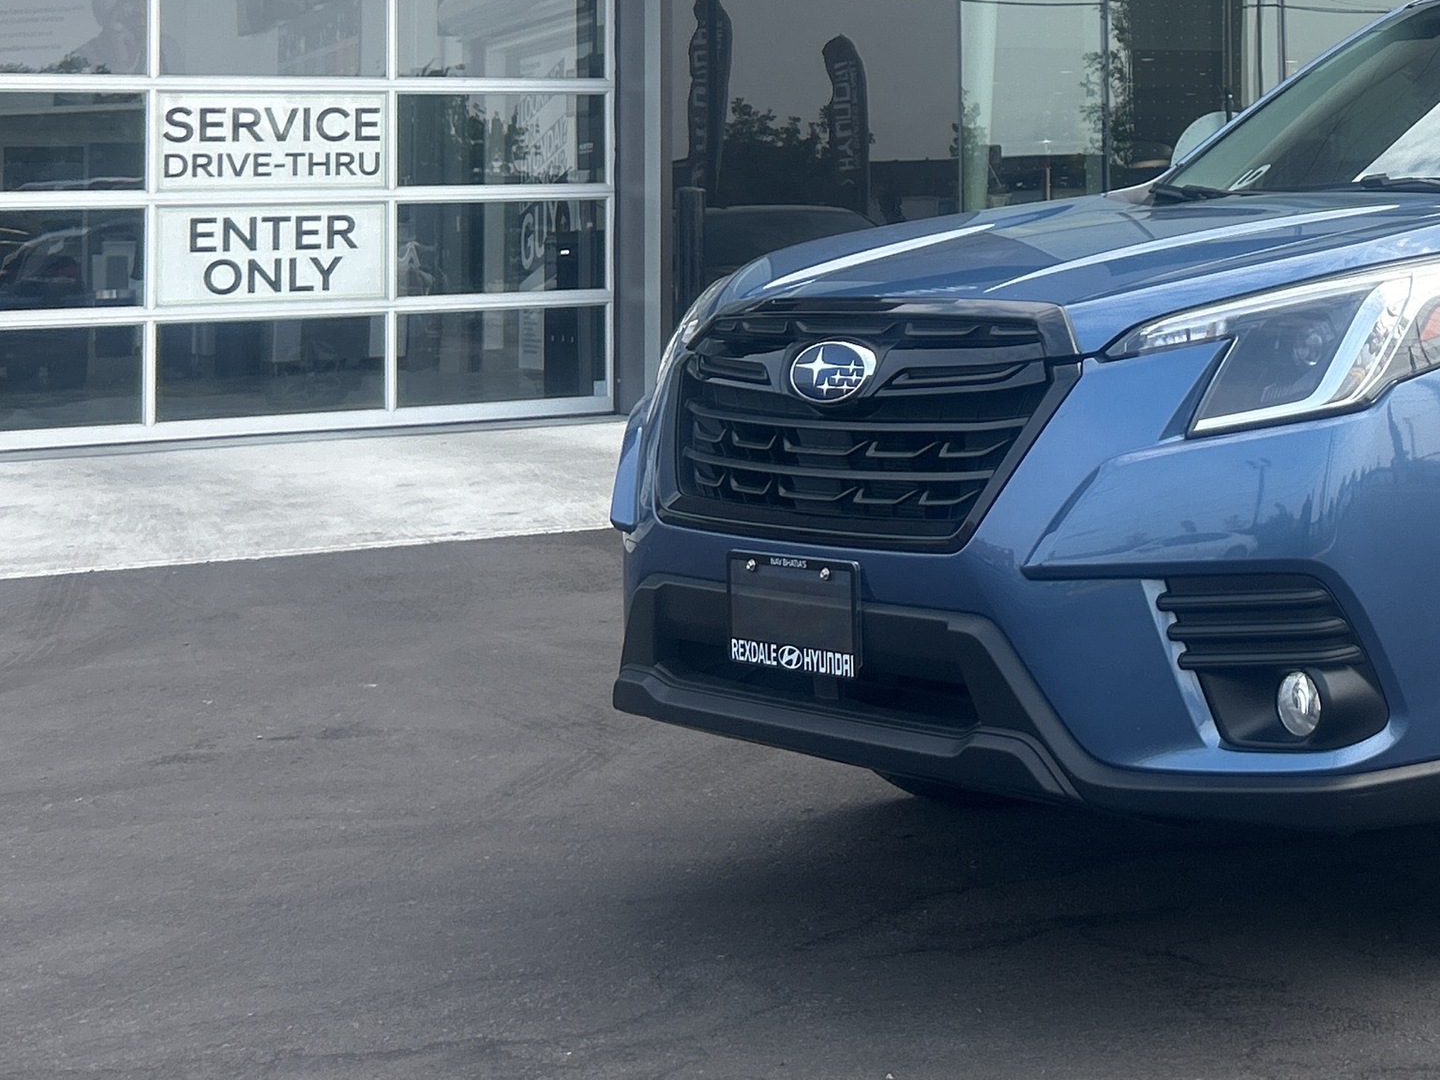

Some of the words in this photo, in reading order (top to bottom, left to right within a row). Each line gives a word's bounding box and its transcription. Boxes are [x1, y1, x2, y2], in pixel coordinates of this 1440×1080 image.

[163, 107, 381, 143] SERVICE
[164, 152, 380, 178] DRIVE-THRU
[189, 215, 358, 253] ENTER
[203, 256, 343, 295] ONLY
[731, 638, 778, 666] REXDALE
[803, 648, 855, 678] HYUNDAI
